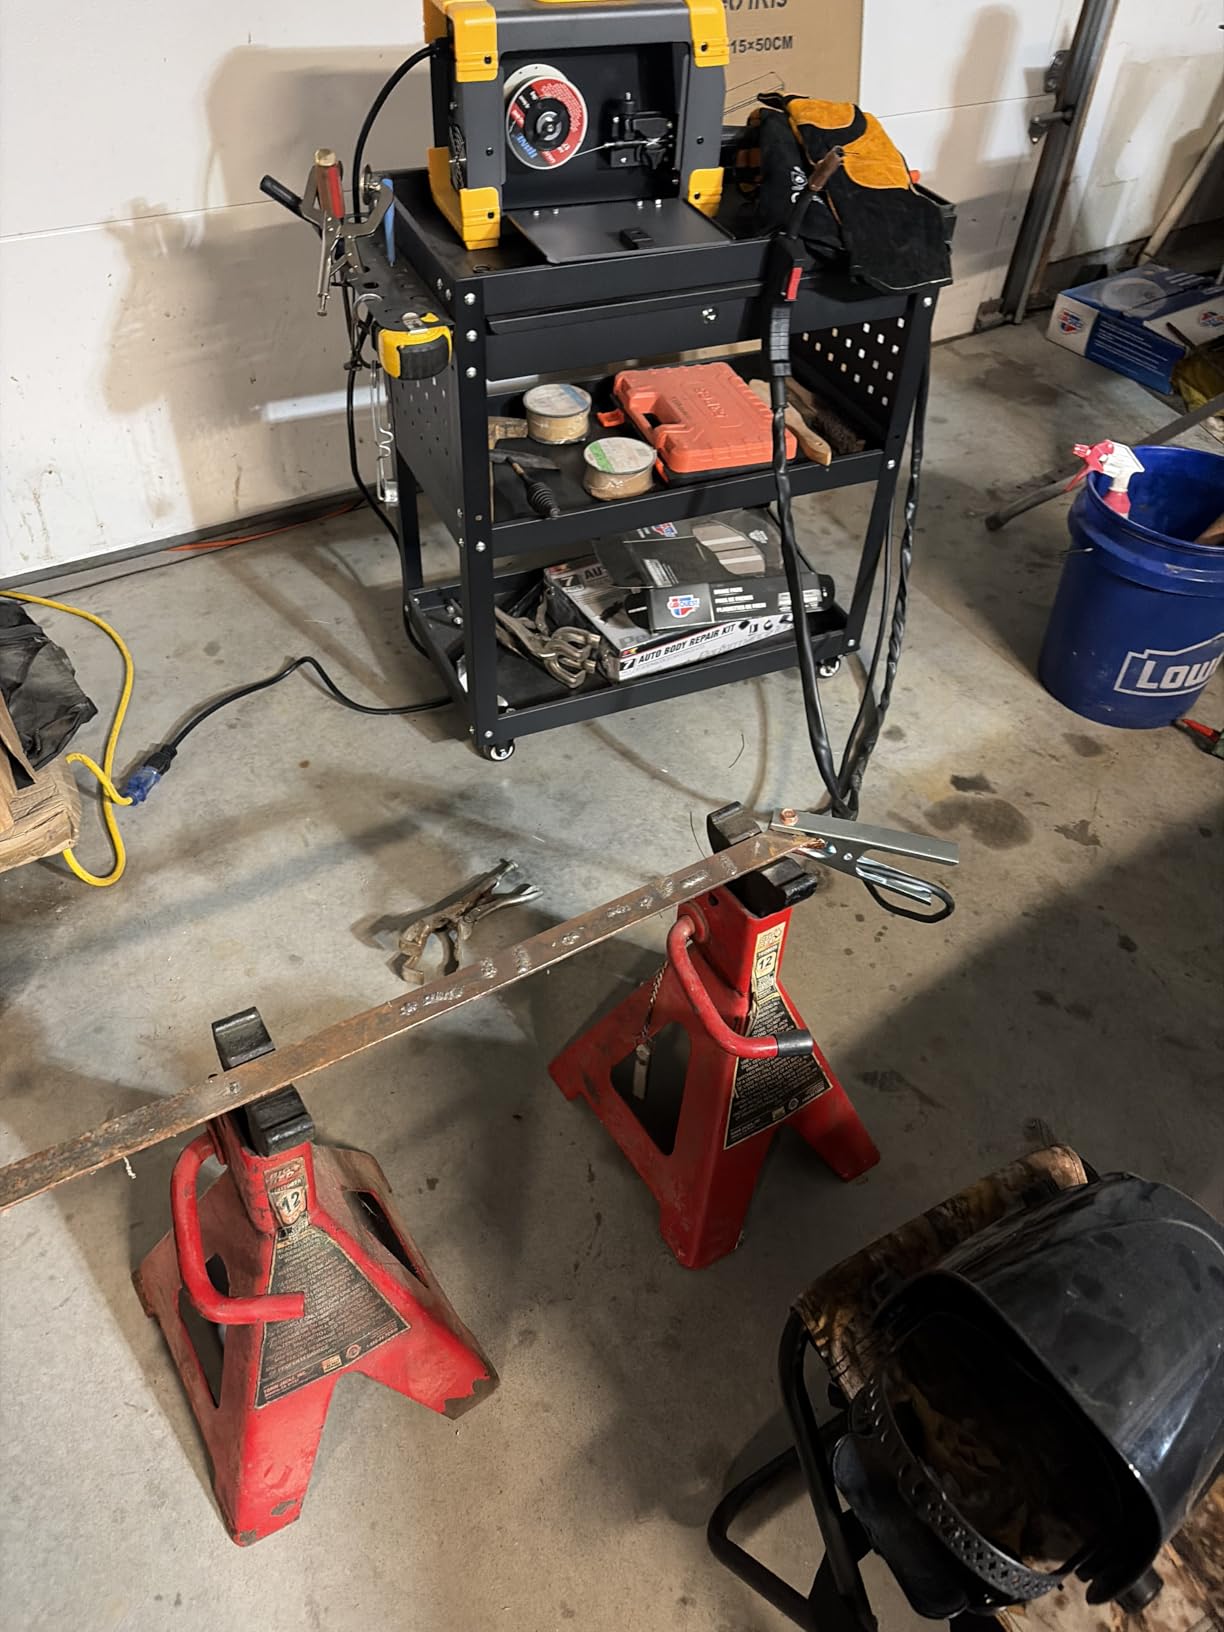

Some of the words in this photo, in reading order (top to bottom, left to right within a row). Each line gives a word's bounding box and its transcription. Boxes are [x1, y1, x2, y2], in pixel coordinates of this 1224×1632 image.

[638, 650, 661, 663] AUTO
[664, 642, 687, 655] BODY
[689, 630, 719, 646] REPAIR
[721, 624, 736, 635] KIT
[1136, 659, 1219, 689] LOW
[759, 956, 773, 969] 12
[282, 1192, 300, 1213] 12
